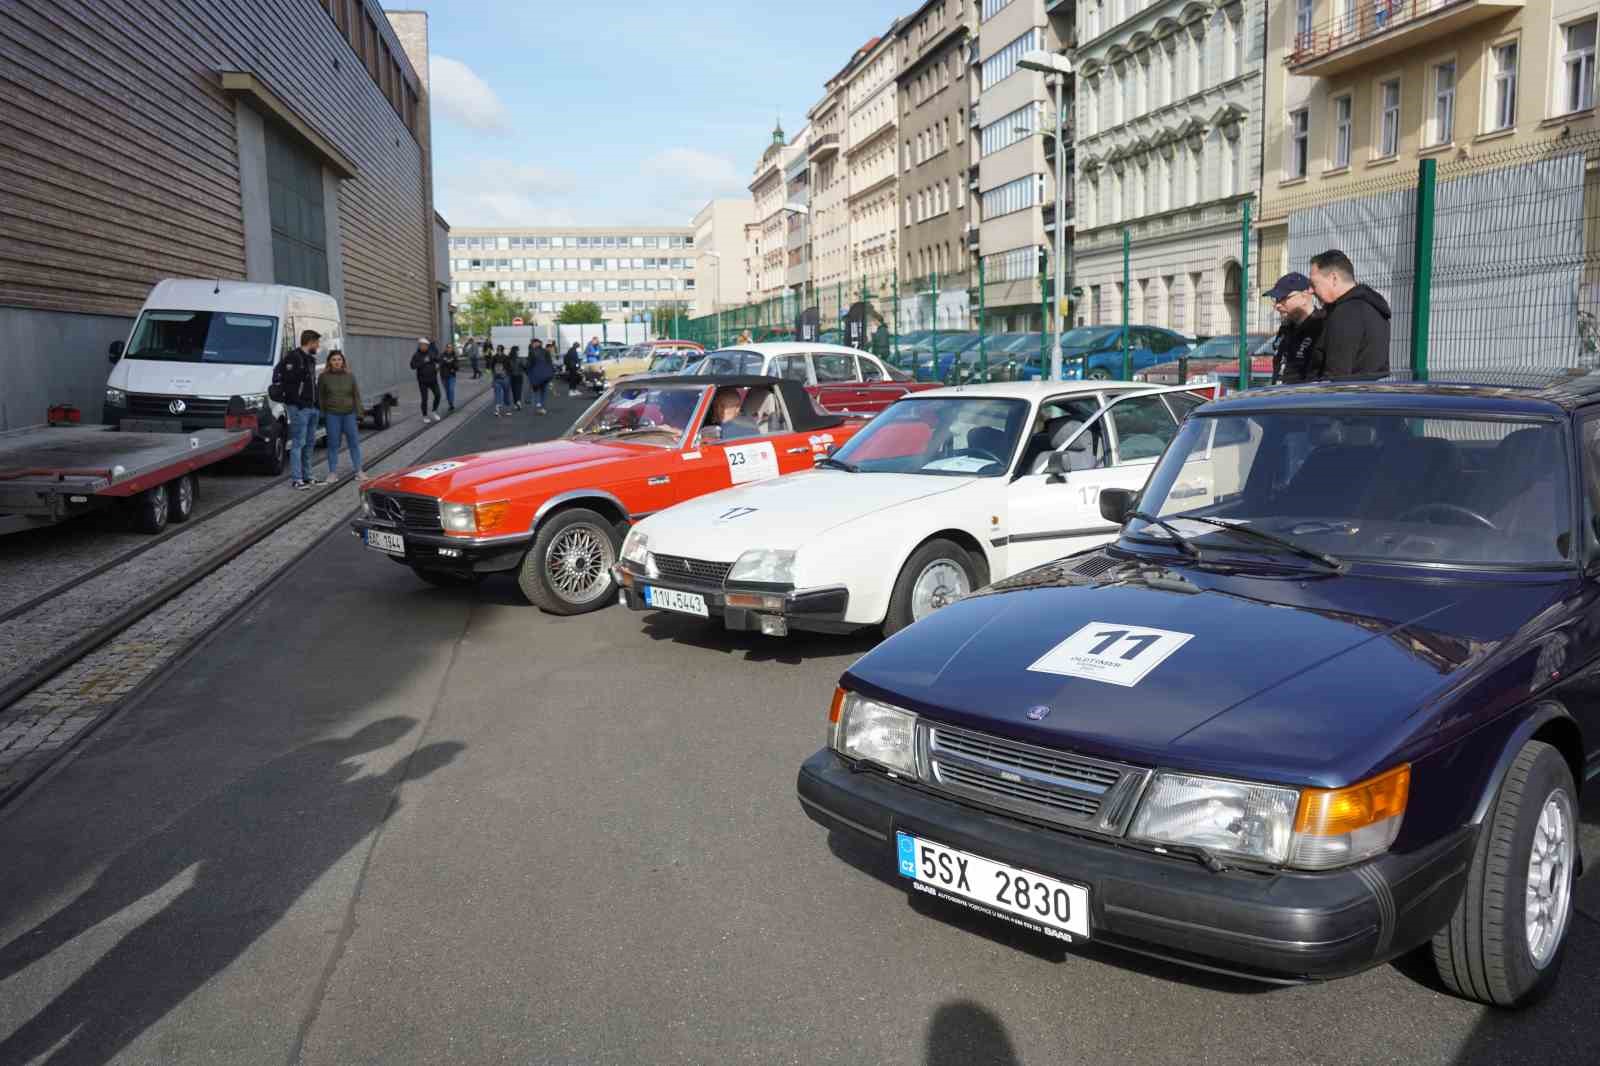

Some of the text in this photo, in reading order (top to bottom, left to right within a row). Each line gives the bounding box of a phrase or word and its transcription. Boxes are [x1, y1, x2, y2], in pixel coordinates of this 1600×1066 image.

[728, 452, 746, 465] 23
[1078, 485, 1100, 504] 17
[1087, 629, 1163, 660] 11
[902, 860, 914, 873] CZ
[920, 846, 971, 892] 5SX
[994, 870, 1071, 923] 2830
